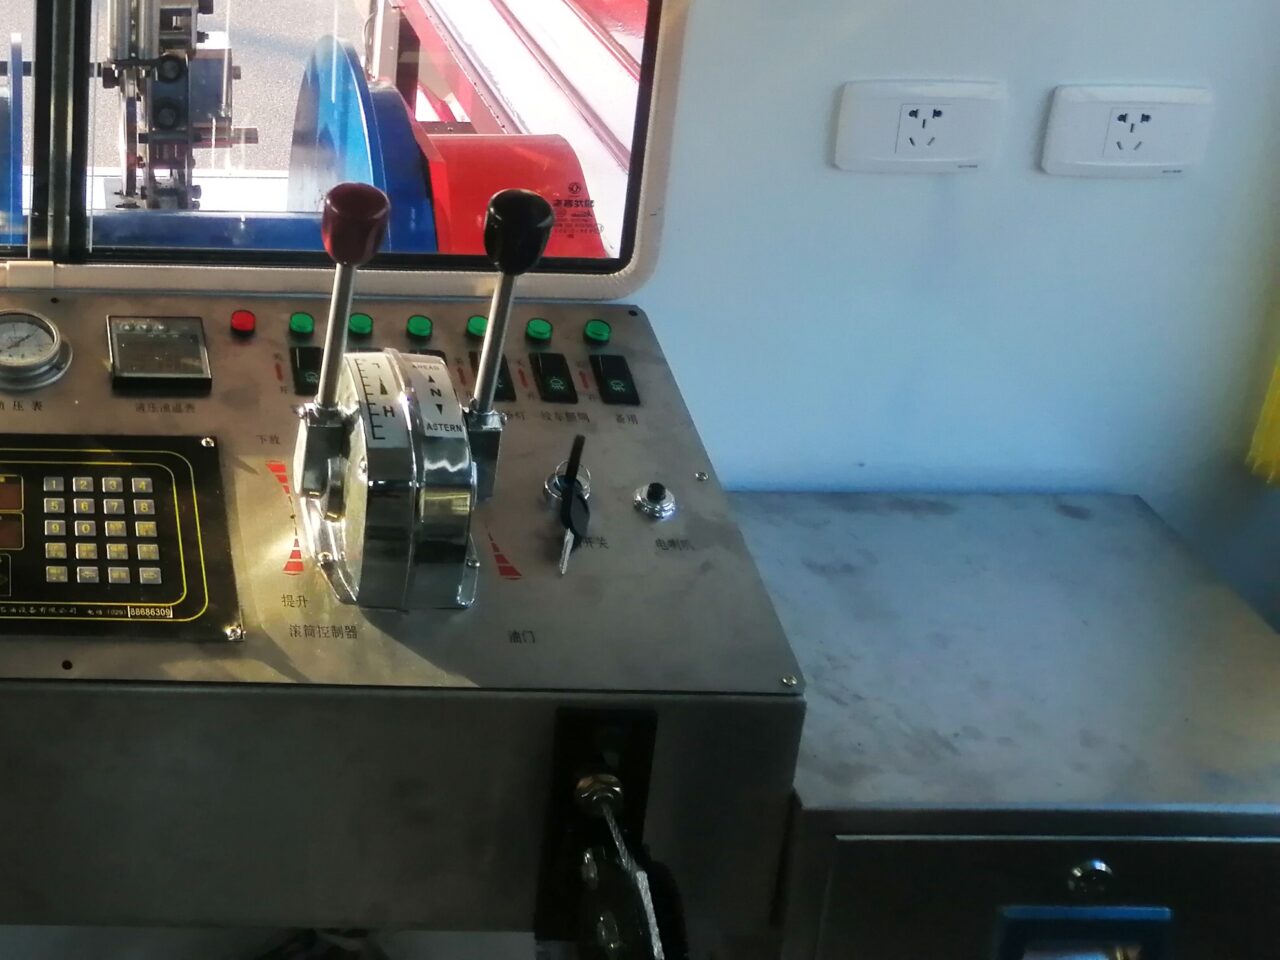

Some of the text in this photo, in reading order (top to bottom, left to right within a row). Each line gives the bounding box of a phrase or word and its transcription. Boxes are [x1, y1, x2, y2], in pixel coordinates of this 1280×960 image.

[430, 389, 442, 397] N
[382, 406, 396, 417] H
[426, 423, 463, 432] ASTERN
[281, 594, 309, 608] 提升
[289, 624, 357, 639] 滚筒控制器
